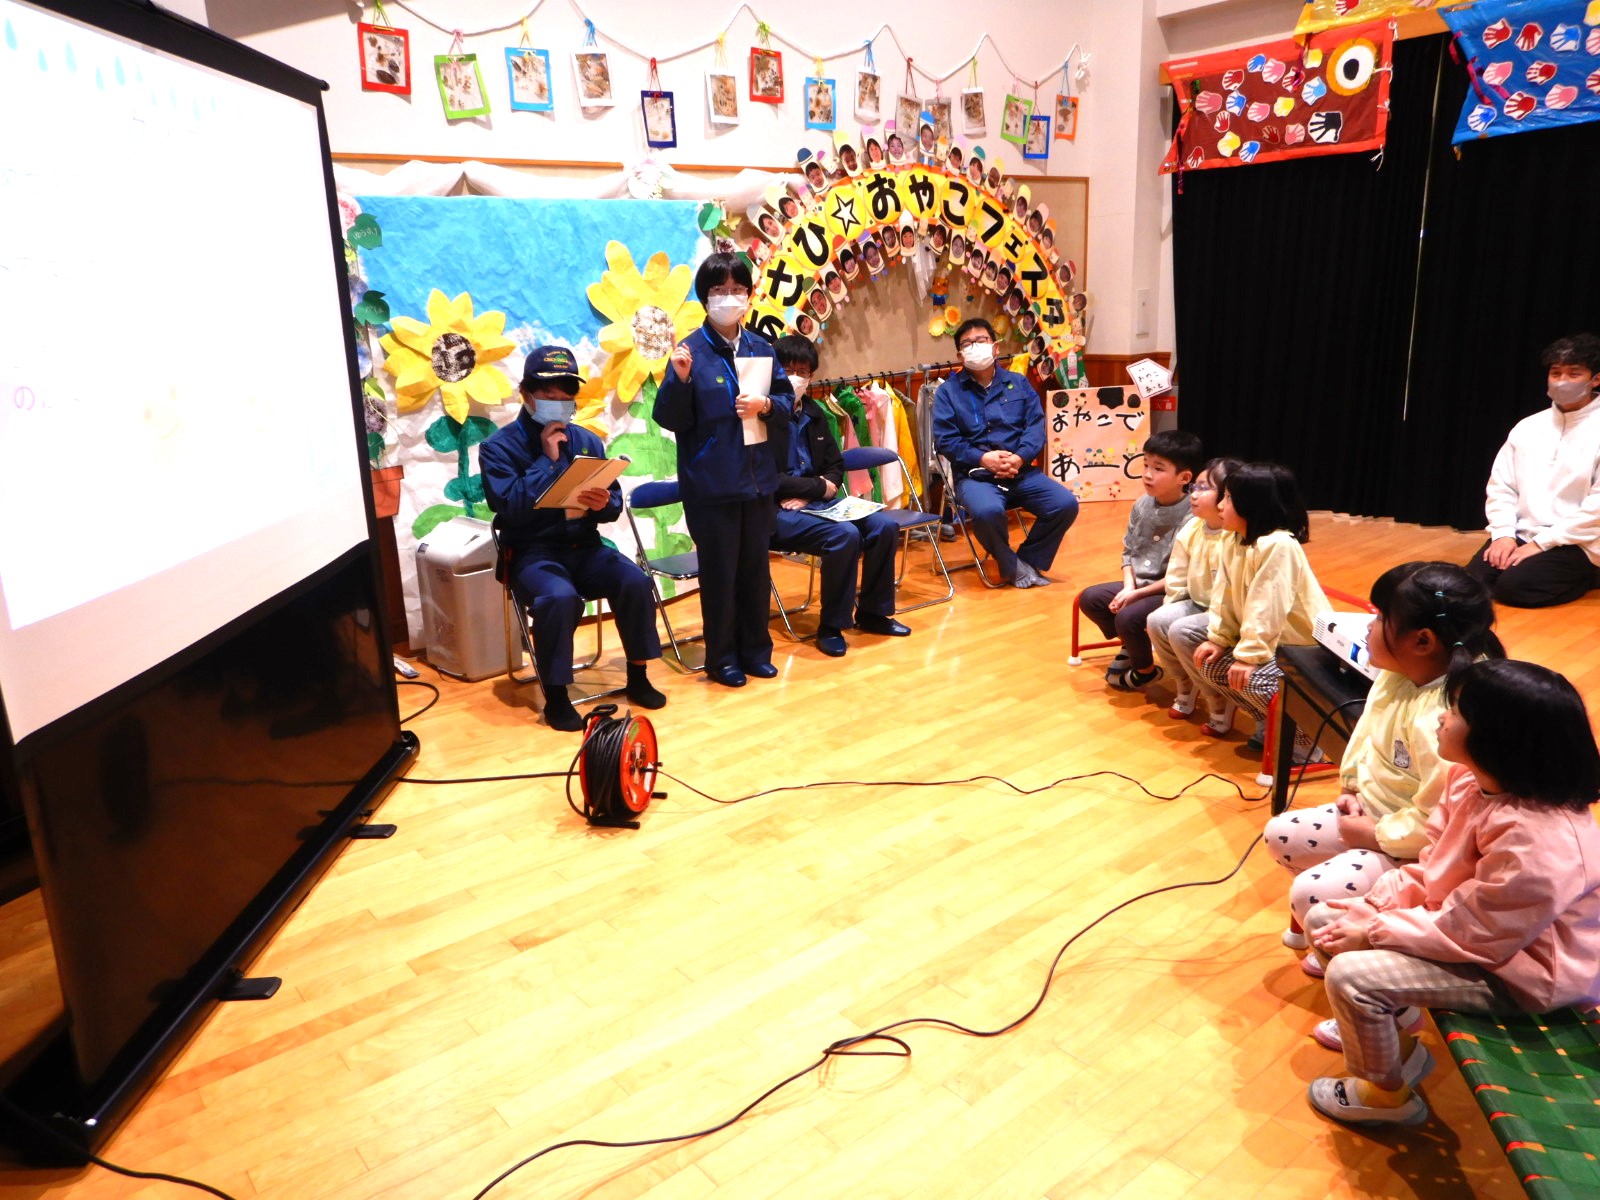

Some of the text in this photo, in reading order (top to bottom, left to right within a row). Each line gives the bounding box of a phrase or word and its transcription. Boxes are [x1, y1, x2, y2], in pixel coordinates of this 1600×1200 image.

[1052, 406, 1145, 433] おやこで
[1051, 453, 1145, 482] あーと
